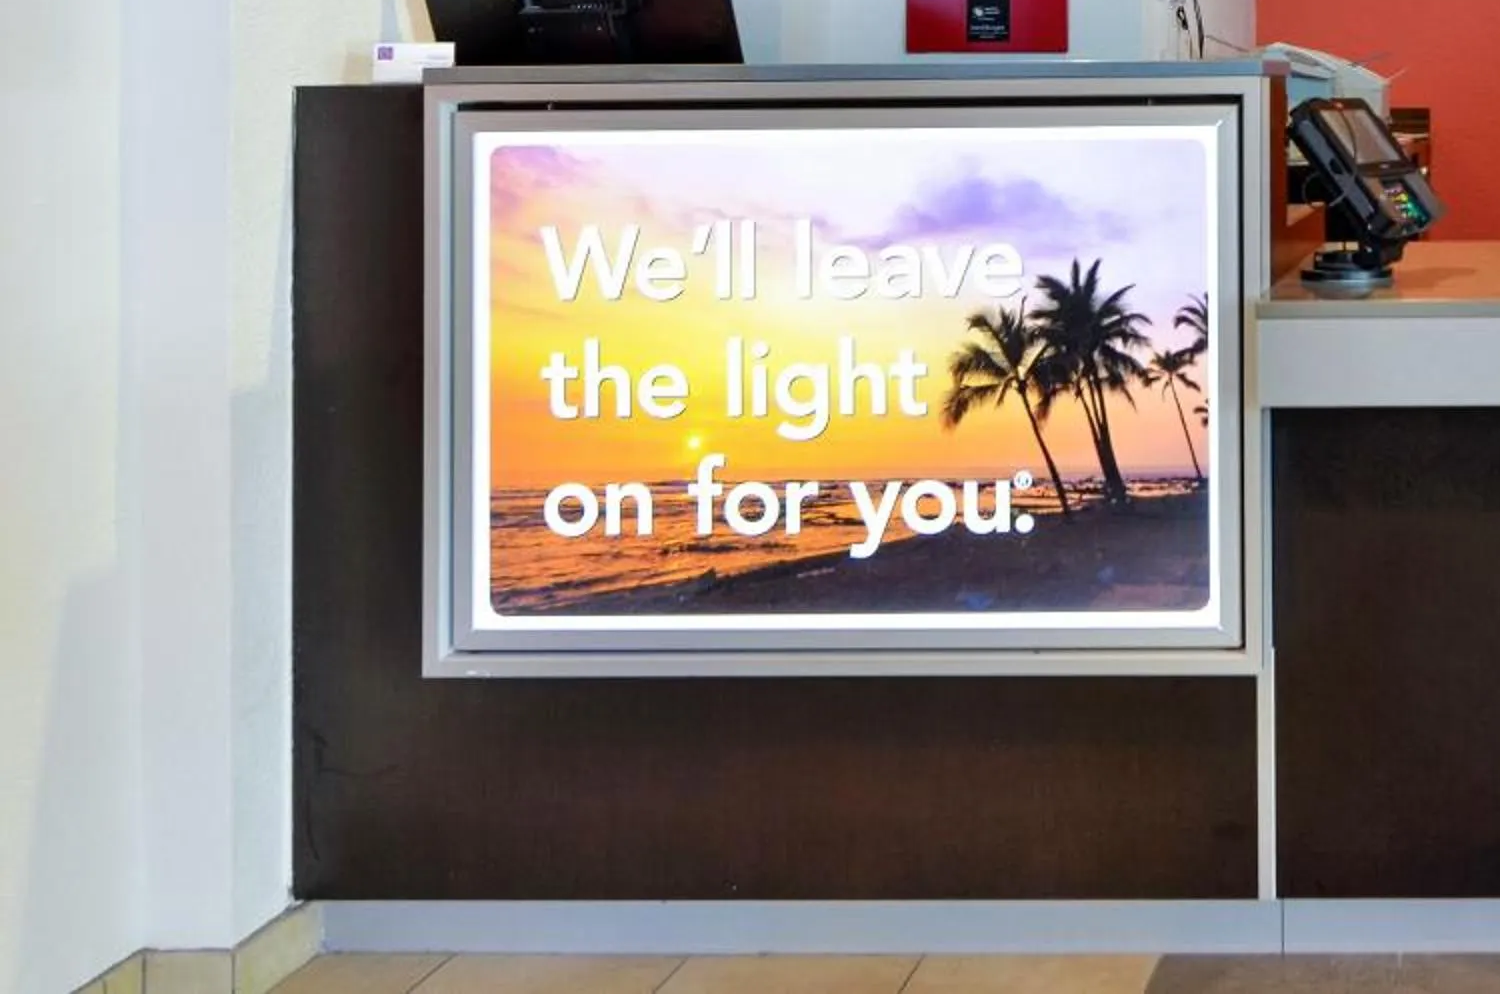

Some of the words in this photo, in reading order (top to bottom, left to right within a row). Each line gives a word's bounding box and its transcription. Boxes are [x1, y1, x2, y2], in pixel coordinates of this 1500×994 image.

[541, 219, 757, 302] We'll
[800, 219, 1025, 300] leave
[541, 337, 690, 420] the
[727, 336, 929, 442] light
[543, 478, 654, 539] on
[688, 454, 818, 536] for
